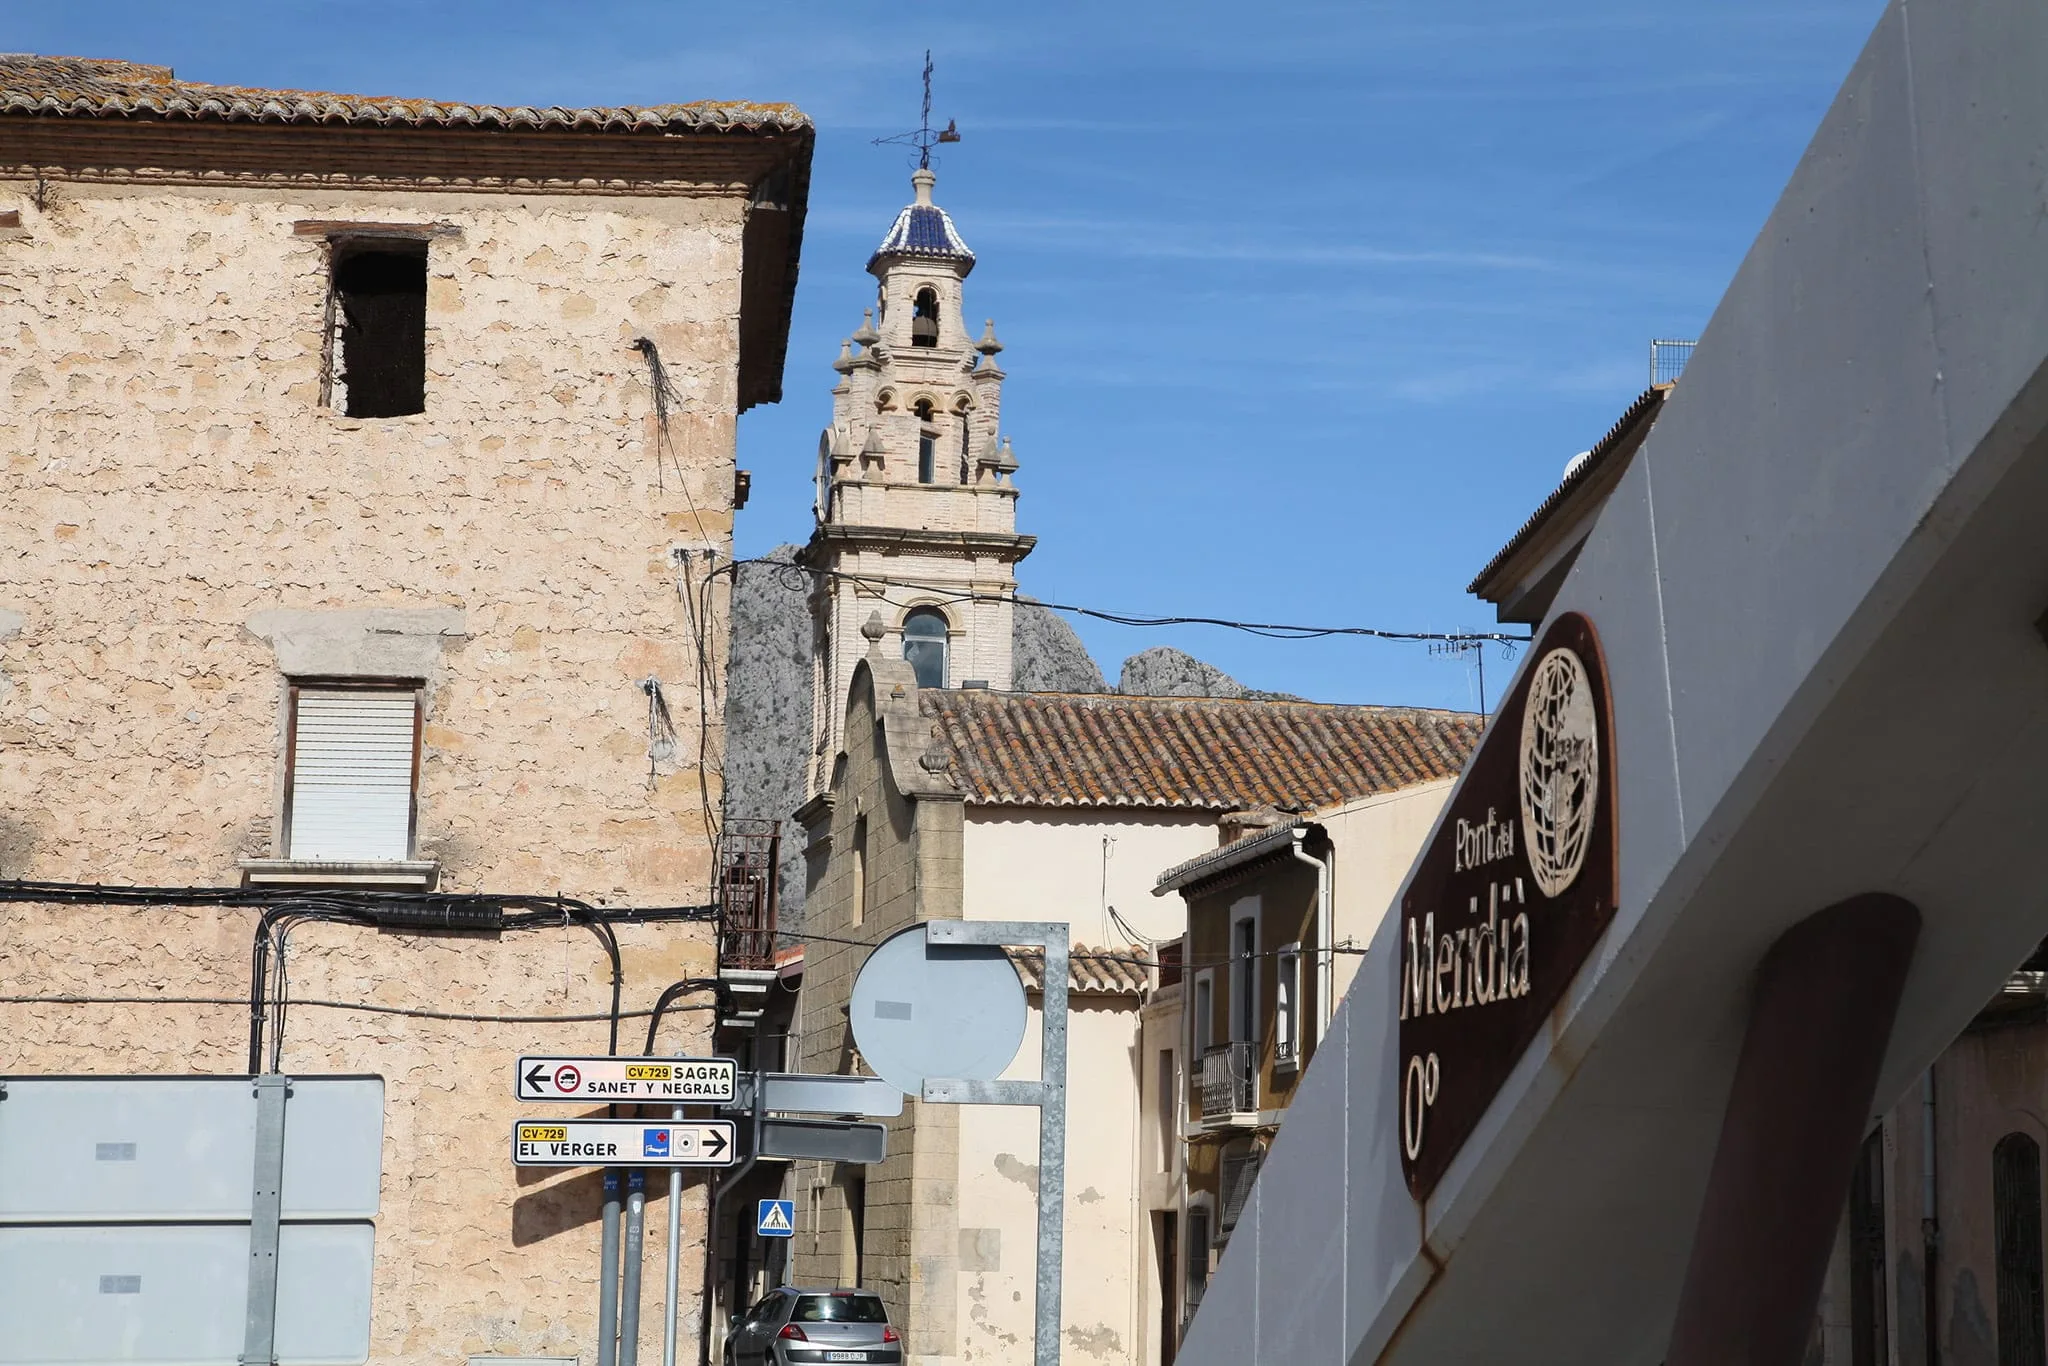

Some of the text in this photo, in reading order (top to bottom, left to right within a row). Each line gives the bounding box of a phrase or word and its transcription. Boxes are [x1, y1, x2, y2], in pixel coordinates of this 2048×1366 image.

[1455, 807, 1514, 872] Pont del
[1400, 877, 1530, 1020] Meridià
[628, 1067, 730, 1080] CV-729 SAGRA
[588, 1082, 730, 1095] SANET Y NEGRALS
[522, 1129, 565, 1139] CV-729
[519, 1143, 617, 1156] EL VERGER
